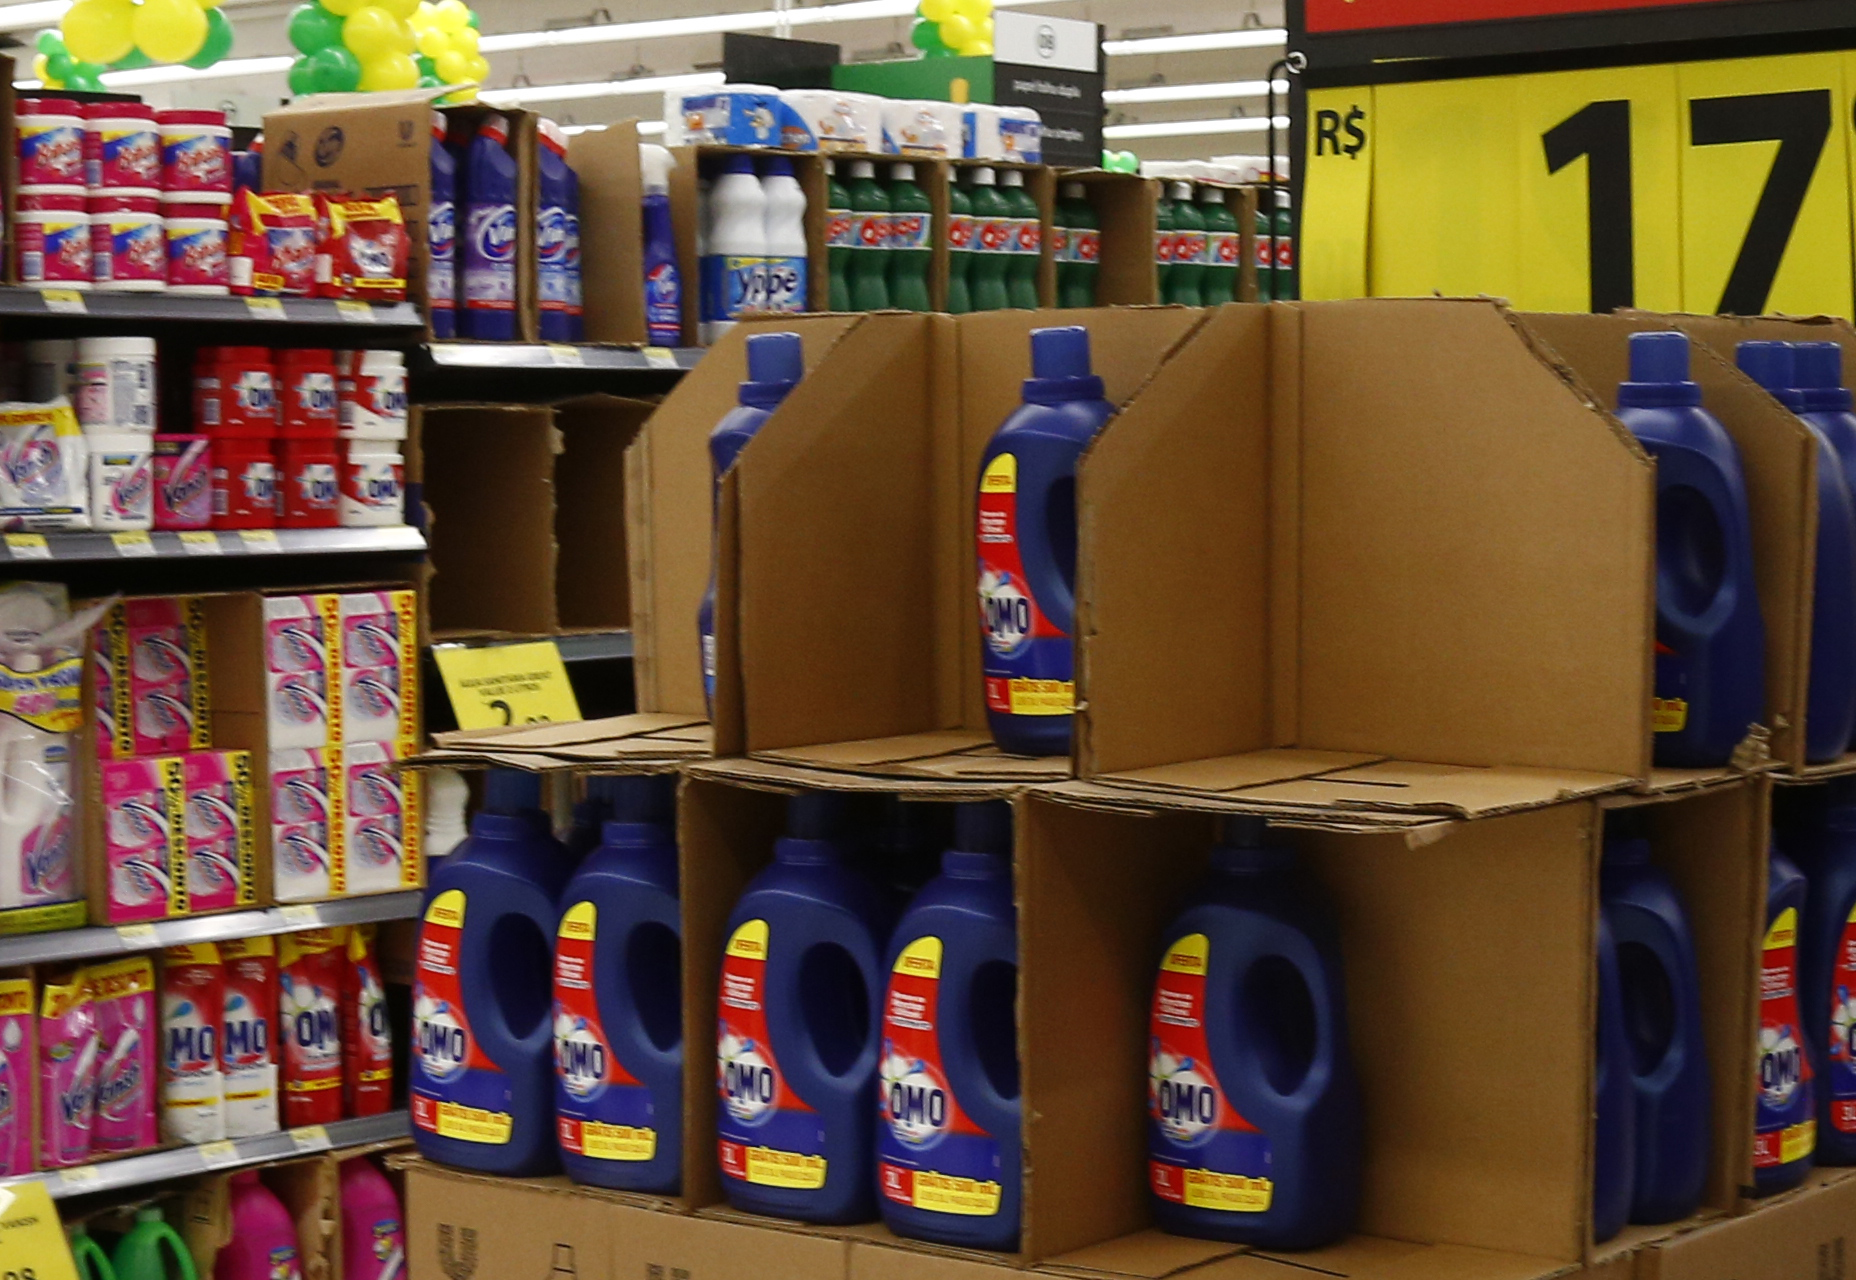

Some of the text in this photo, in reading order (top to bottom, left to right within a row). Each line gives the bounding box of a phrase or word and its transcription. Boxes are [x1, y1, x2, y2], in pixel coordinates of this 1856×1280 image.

[1316, 105, 1366, 159] R$
[170, 1025, 215, 1062] MO
[226, 1019, 268, 1054] MO
[296, 1009, 338, 1049] OM
[420, 1019, 465, 1065] OMO
[561, 1034, 605, 1081] OMO
[725, 1060, 773, 1104] OMO
[890, 1081, 945, 1128] OMO
[1160, 1079, 1214, 1125] OMO
